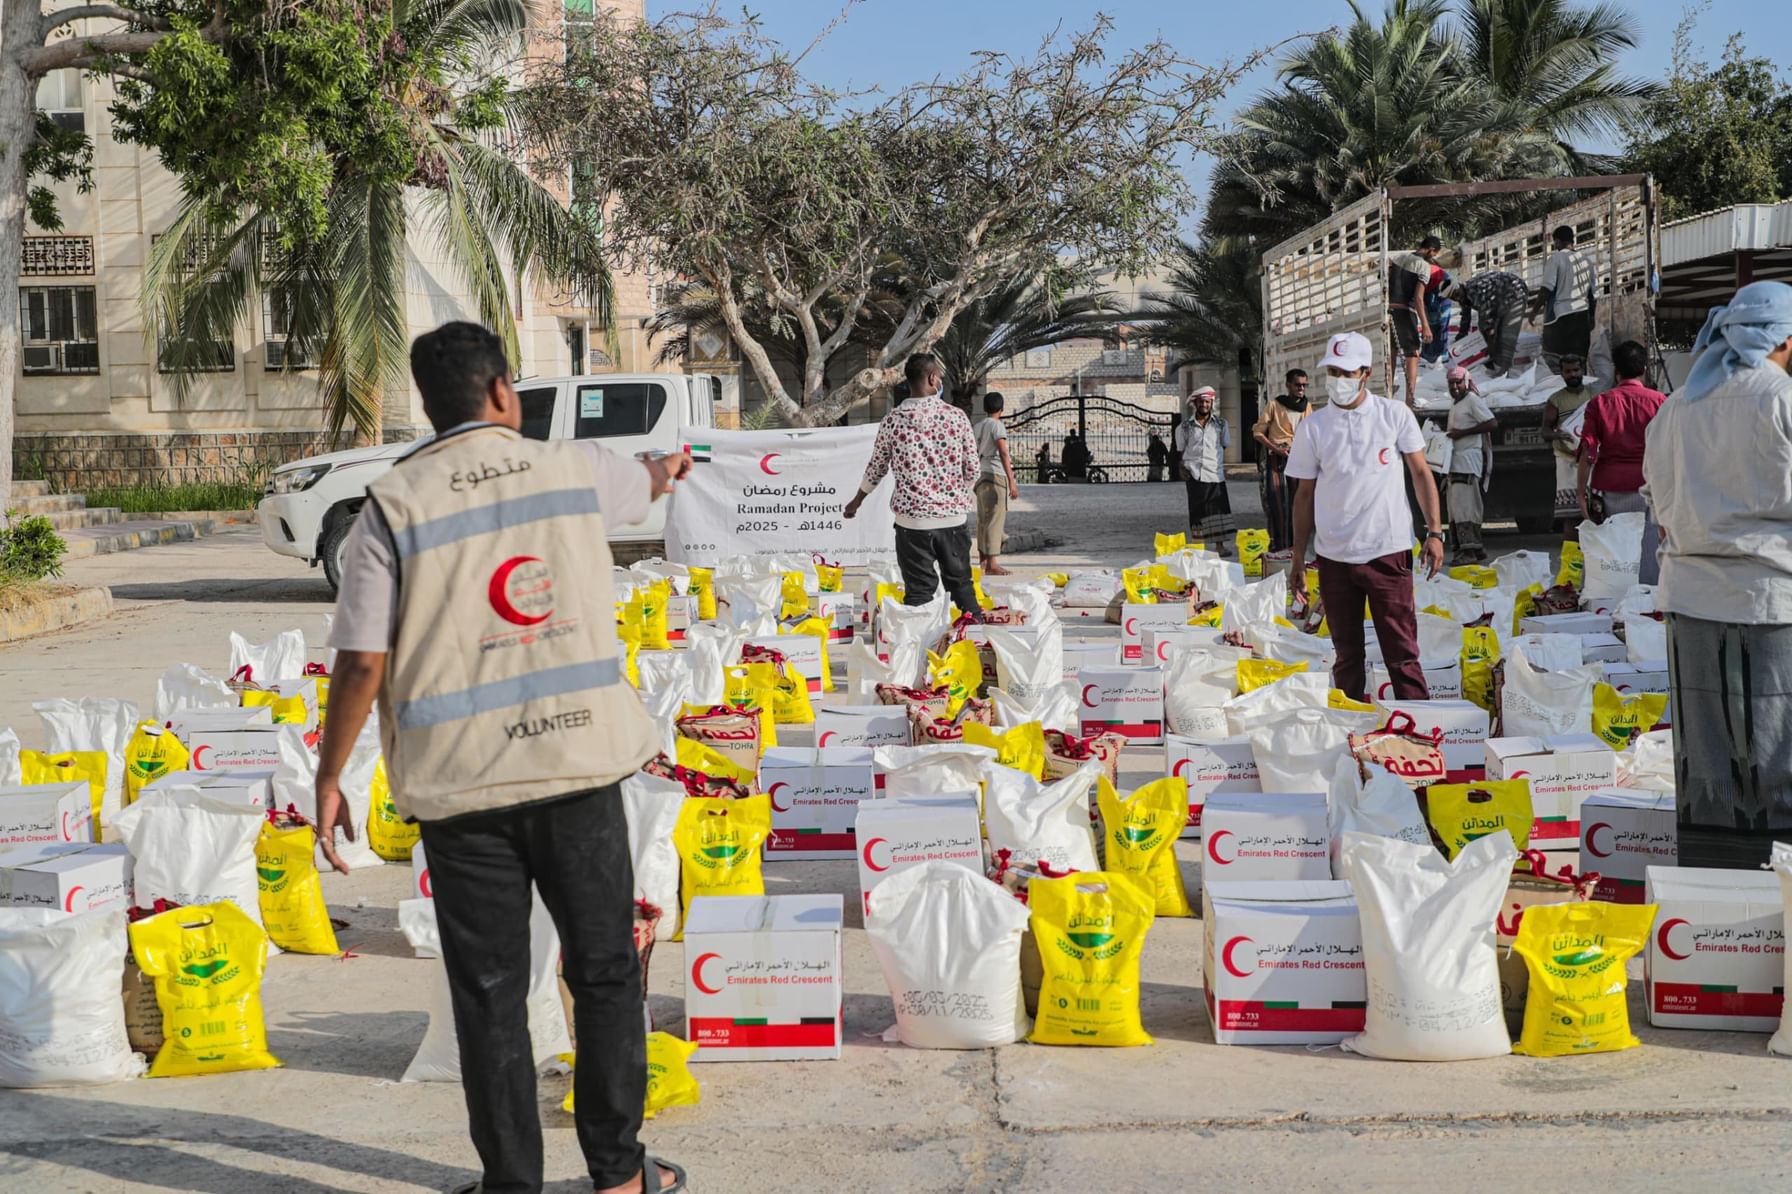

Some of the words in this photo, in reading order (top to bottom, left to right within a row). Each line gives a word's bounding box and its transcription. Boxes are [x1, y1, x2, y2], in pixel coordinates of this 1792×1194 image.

[449, 457, 531, 491] متطوع
[743, 484, 786, 497] رمضان
[790, 481, 836, 496] مشروع
[737, 503, 795, 515] Ramadan
[800, 502, 843, 515] Project
[504, 709, 593, 739] VOLUNTEER
[1384, 751, 1444, 777] تحفة
[1535, 785, 1566, 793] Emirates
[1568, 784, 1581, 792] Red
[793, 798, 822, 806] Emirates
[838, 798, 859, 806] Cresc
[1462, 815, 1504, 830] المدائن
[11, 835, 25, 843] Red
[26, 834, 58, 842] Crescent
[1237, 849, 1271, 857] Emirates
[1291, 850, 1326, 858] Crescent
[1615, 843, 1651, 853] Emirates
[1652, 846, 1669, 855] Red
[892, 854, 926, 863] Emirates
[927, 852, 942, 861] Red
[945, 850, 978, 859] Crescent
[179, 943, 227, 963] المدائن
[1695, 943, 1738, 953] Emirates
[1741, 944, 1761, 953] Red
[1763, 944, 1784, 953] Cres
[1258, 960, 1299, 969] Emirates
[1302, 960, 1321, 969] Red
[1323, 960, 1365, 969] Crescent
[727, 975, 768, 984] Emirates
[770, 975, 789, 984] Red
[791, 975, 833, 984] Crescent
